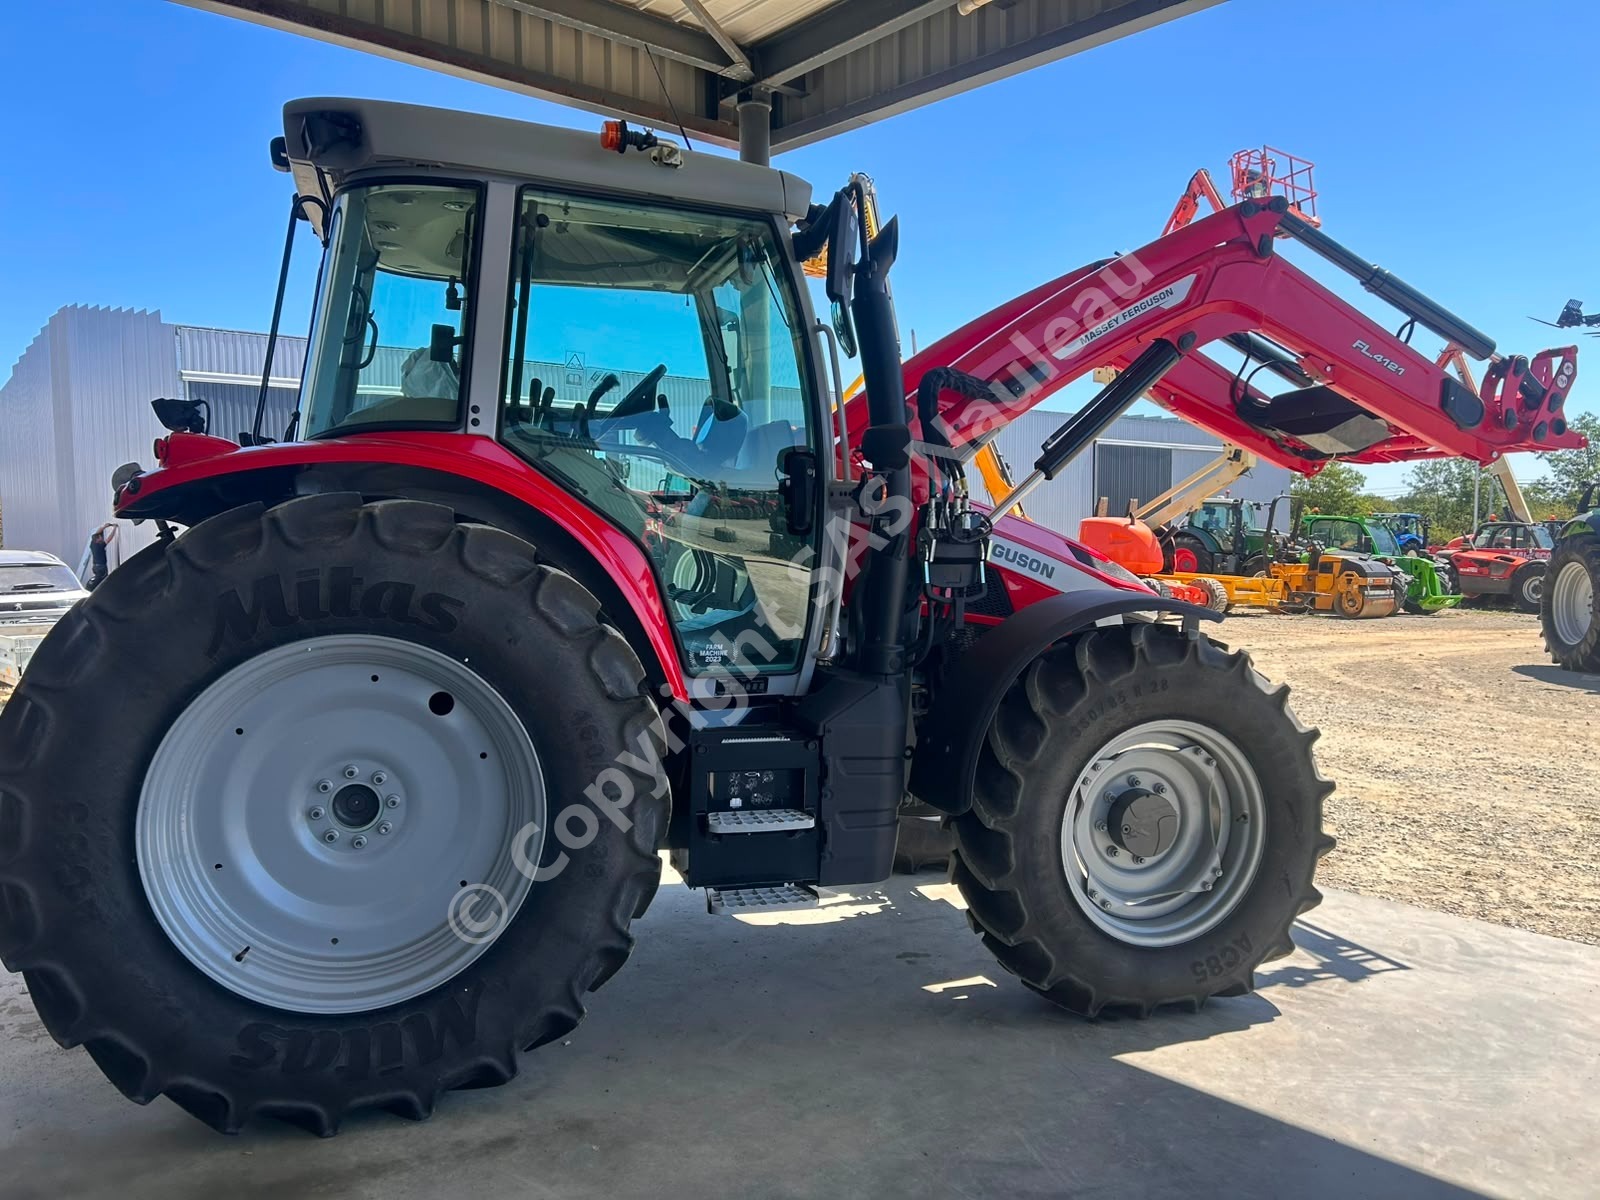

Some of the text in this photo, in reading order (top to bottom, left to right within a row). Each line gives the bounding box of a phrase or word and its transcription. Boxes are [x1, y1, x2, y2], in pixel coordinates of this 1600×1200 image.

[1079, 287, 1174, 346] MASSEY FERGUSON
[1351, 339, 1406, 376] FL.4121
[991, 543, 1055, 579] GUSON
[203, 566, 466, 663] Mitas
[1190, 929, 1254, 985] AC85
[229, 978, 487, 1081] Mitas
